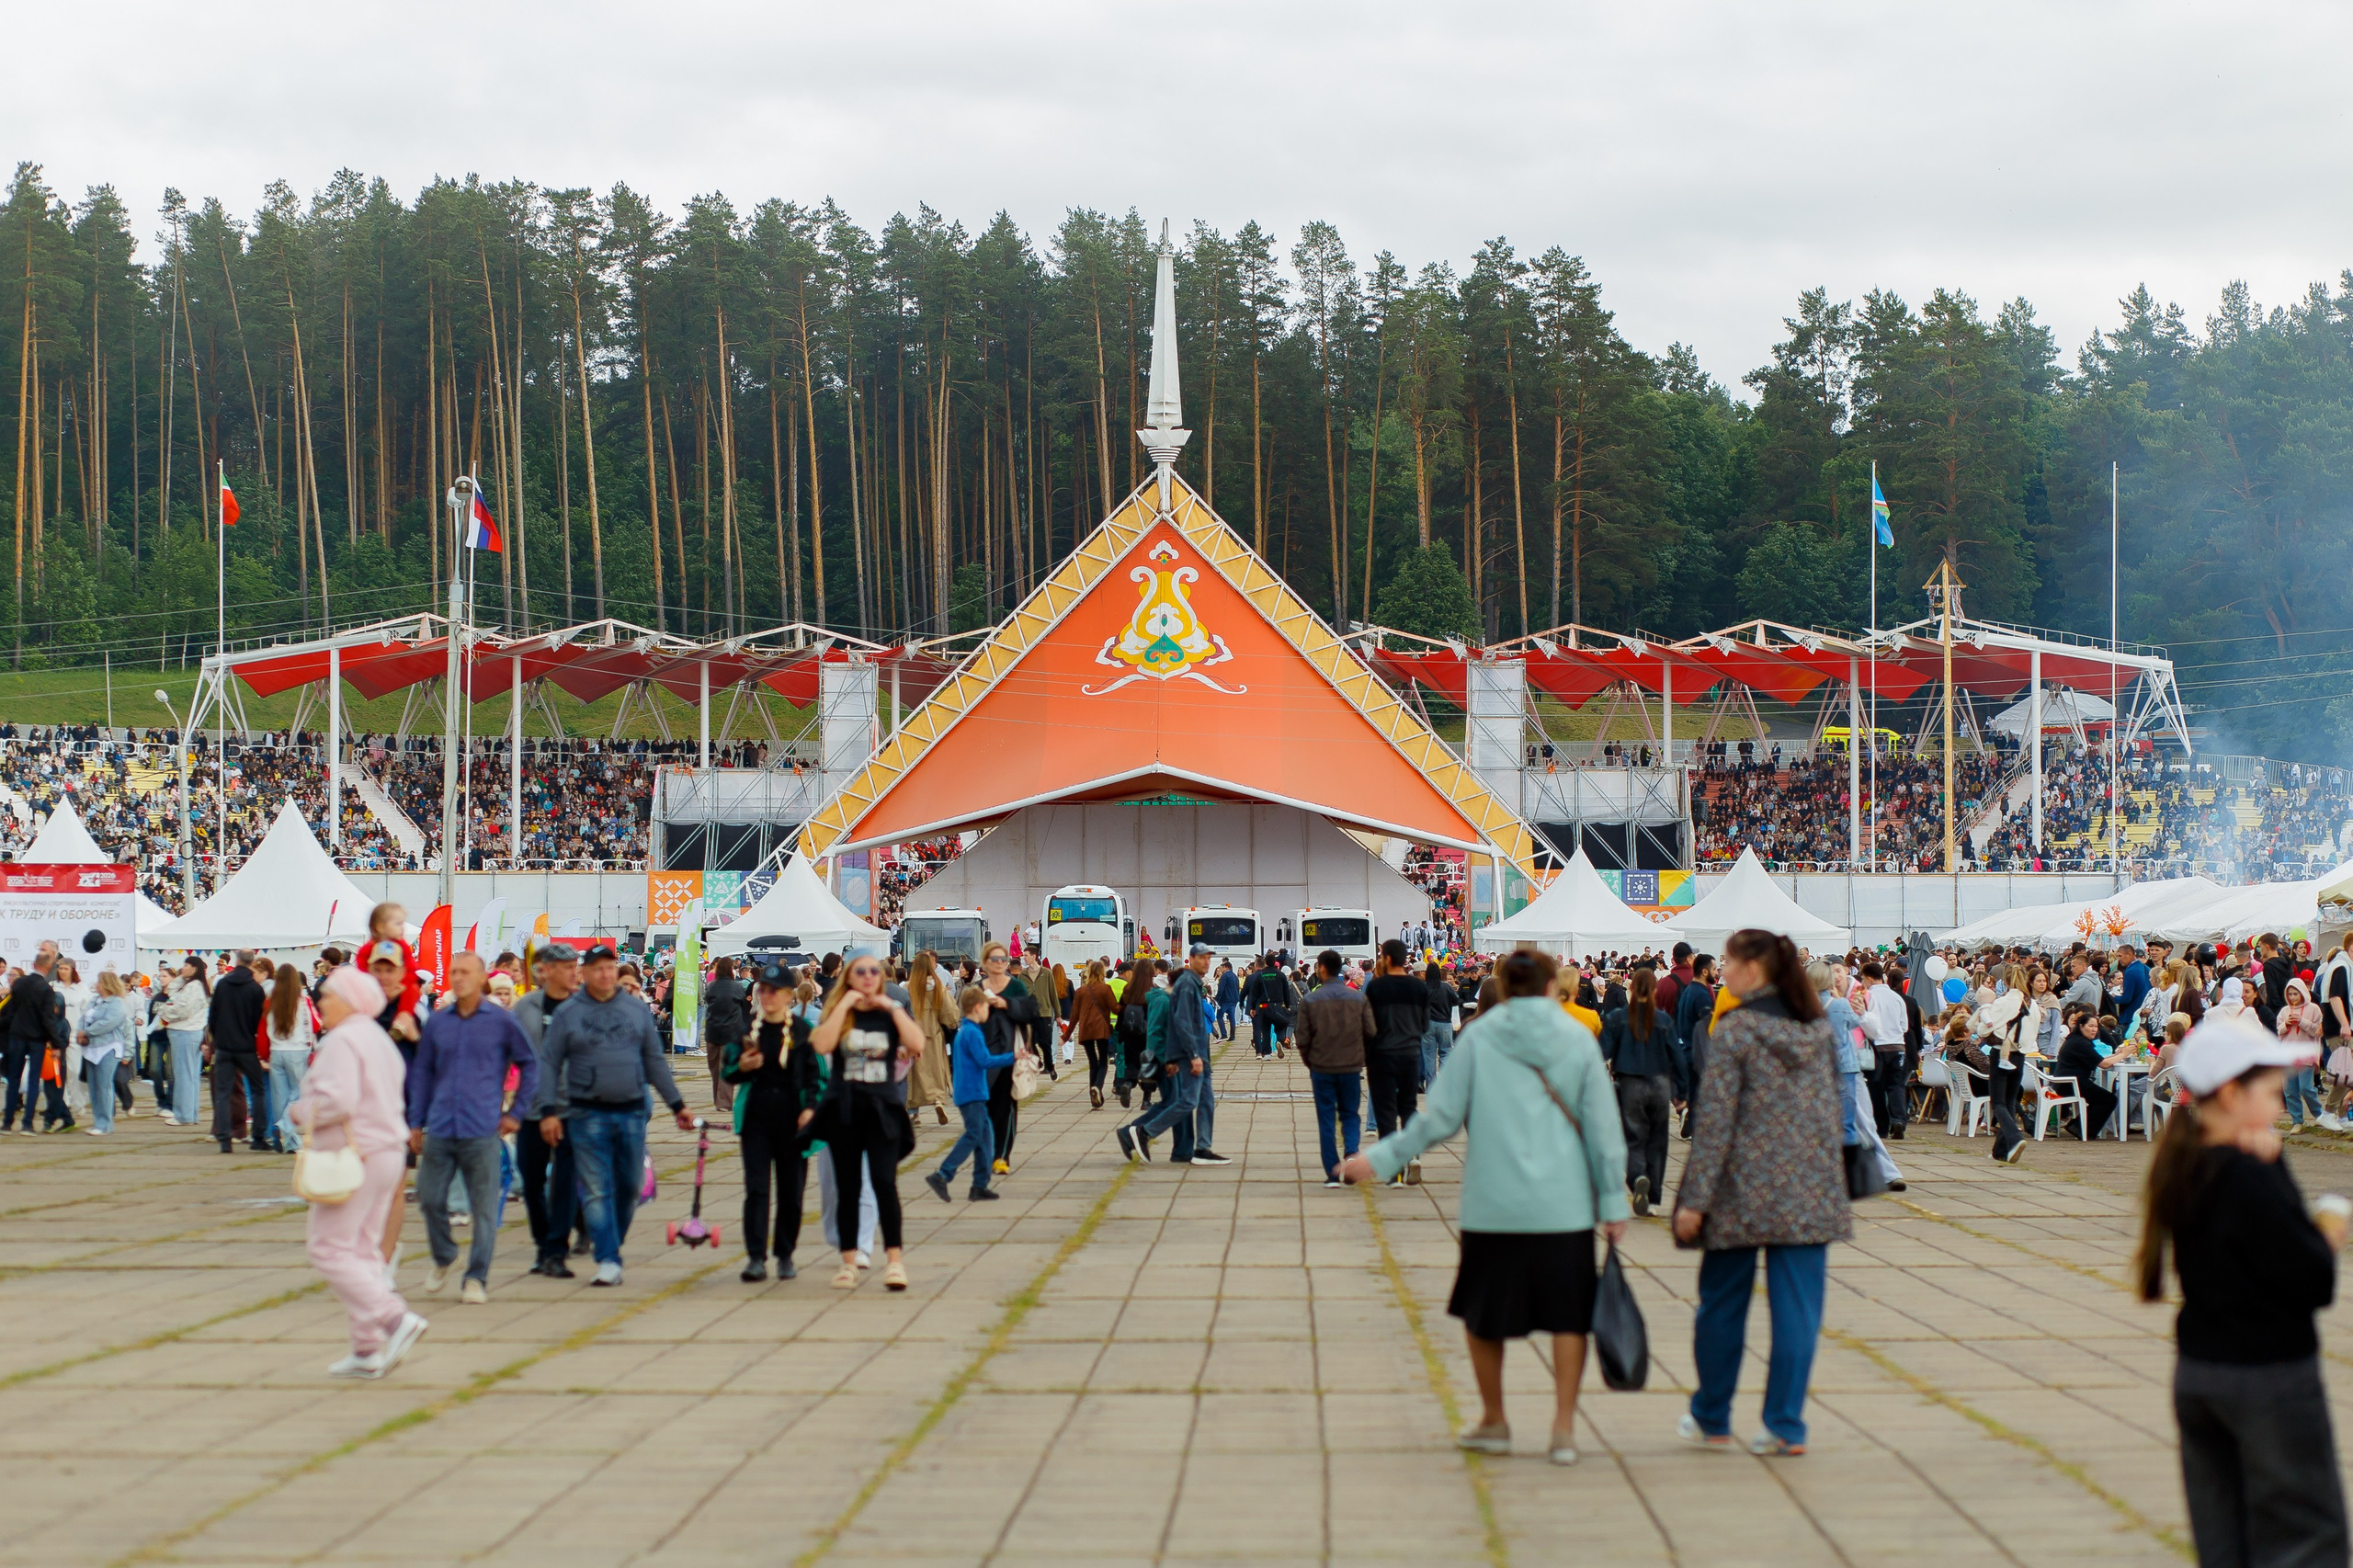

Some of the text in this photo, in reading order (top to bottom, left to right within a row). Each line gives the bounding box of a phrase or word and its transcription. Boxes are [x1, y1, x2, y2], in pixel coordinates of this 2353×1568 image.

[9, 909, 46, 921] ТРУДУ
[48, 909, 57, 920] И
[60, 909, 120, 920] ОБОРОНЕ»
[435, 928, 444, 986] АЛДЫНГЫЛАР
